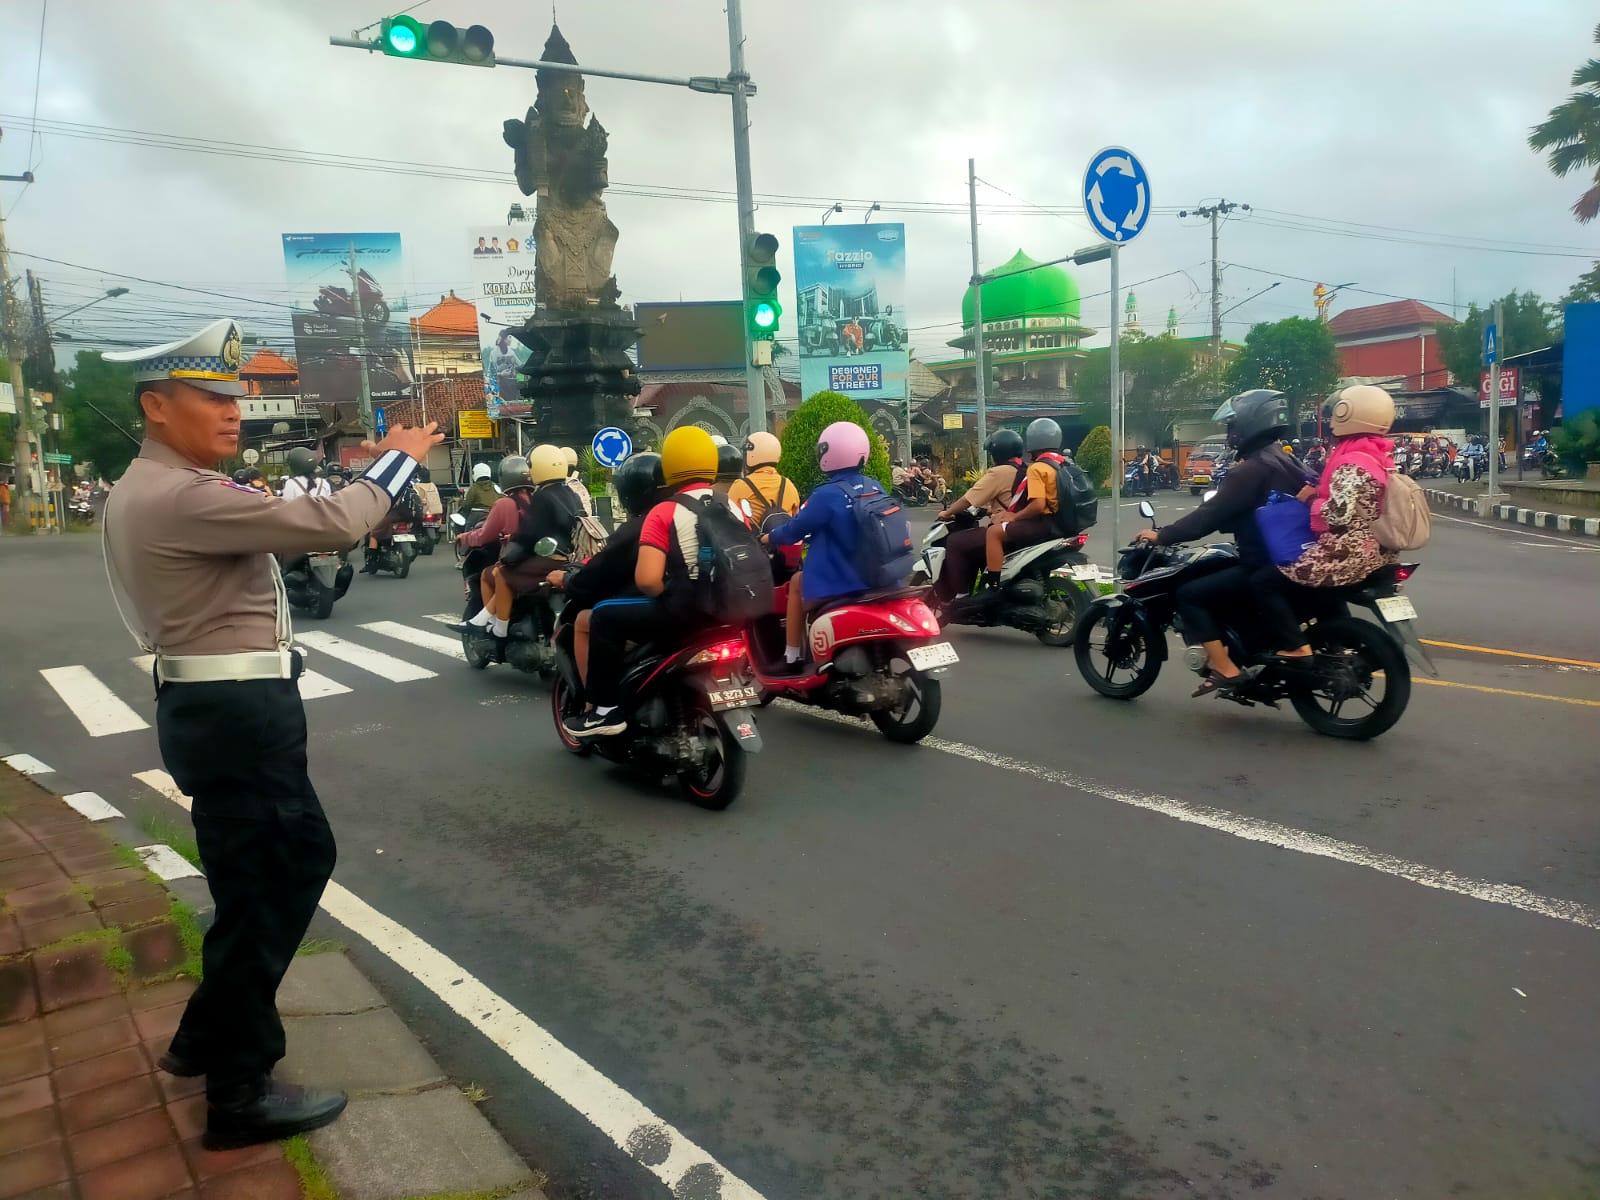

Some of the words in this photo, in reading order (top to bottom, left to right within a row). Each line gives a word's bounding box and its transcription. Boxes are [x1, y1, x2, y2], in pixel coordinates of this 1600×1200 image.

[483, 283, 516, 295] KOTA
[494, 297, 530, 306] Harmony
[831, 366, 878, 374] DESIGNED
[832, 374, 853, 382] FOR
[857, 373, 878, 381] OUR
[832, 380, 879, 390] STREETS
[1482, 377, 1515, 393] GGI
